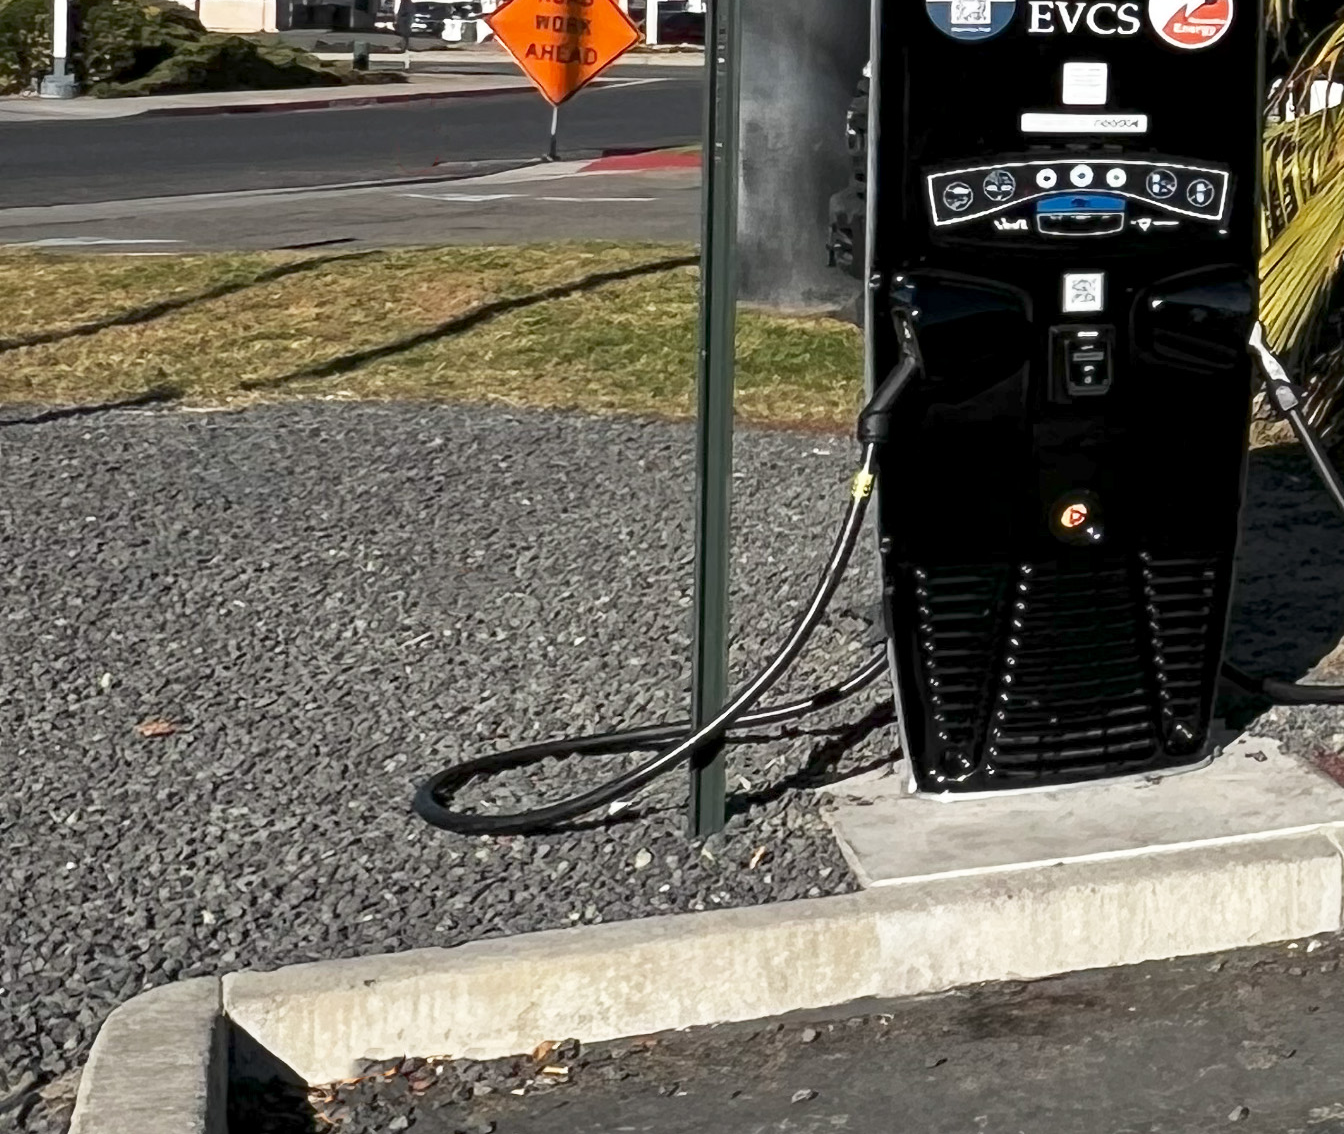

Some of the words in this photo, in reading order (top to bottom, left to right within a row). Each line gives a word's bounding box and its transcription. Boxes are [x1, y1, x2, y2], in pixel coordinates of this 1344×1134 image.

[535, 14, 592, 36] WORK
[1027, 0, 1141, 35] EVCS
[525, 42, 598, 65] AHEAD
